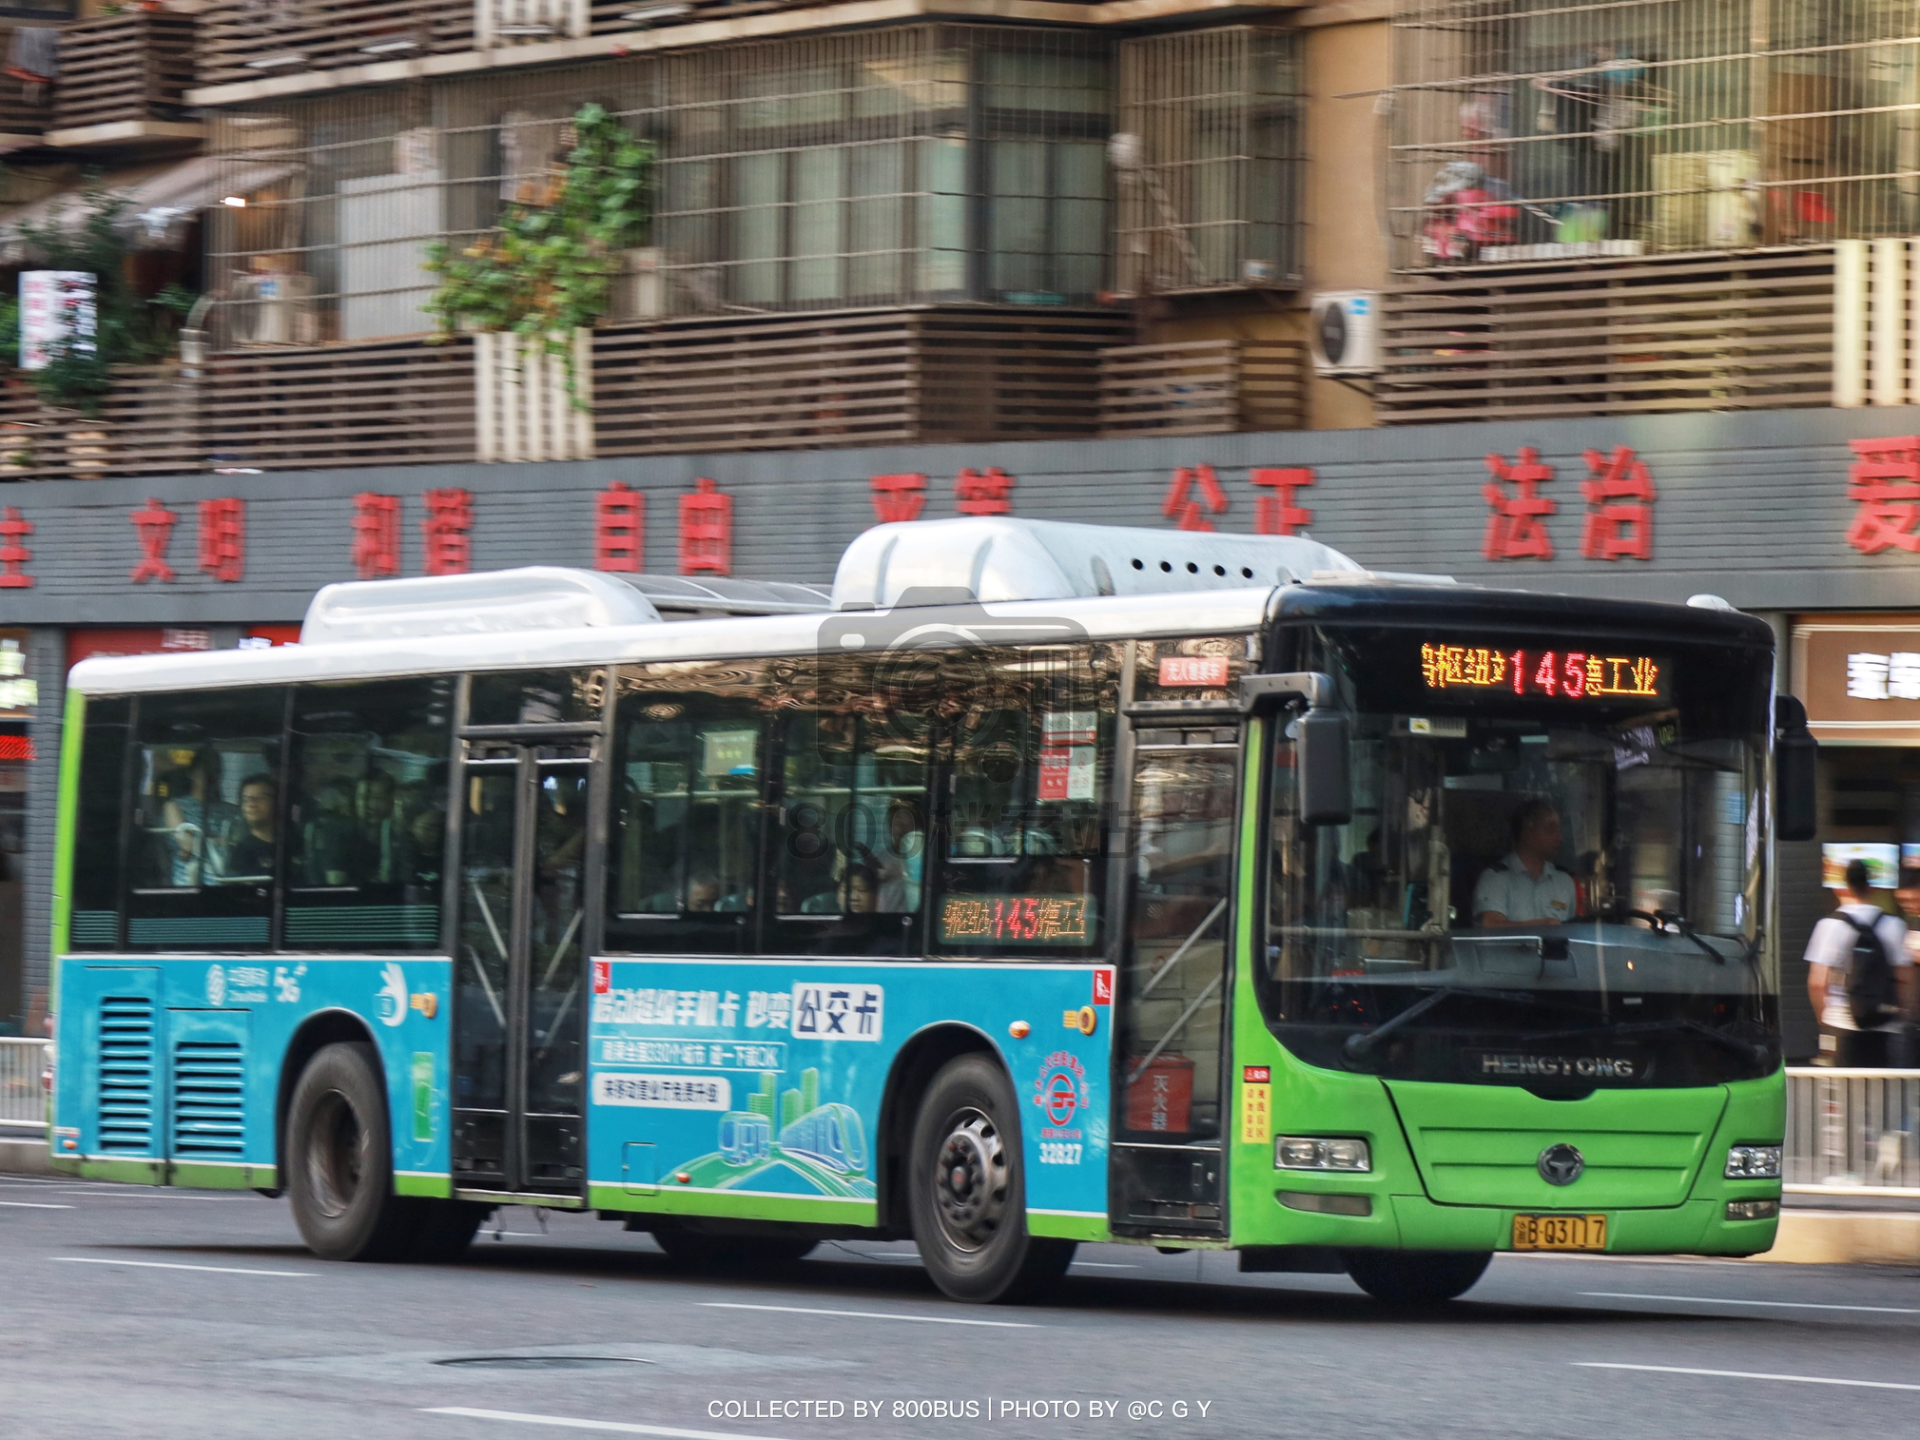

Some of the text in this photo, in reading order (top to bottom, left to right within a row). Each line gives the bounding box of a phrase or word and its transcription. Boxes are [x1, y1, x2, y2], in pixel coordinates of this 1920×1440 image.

[131, 497, 245, 583] 文明
[595, 478, 733, 576] 自由
[1162, 462, 1316, 535] 公正
[1482, 445, 1655, 560] 法治
[1510, 650, 1587, 697] 145
[993, 898, 1038, 939] 145
[797, 989, 879, 1034] 公交卡
[1151, 1074, 1170, 1131] 灭火器
